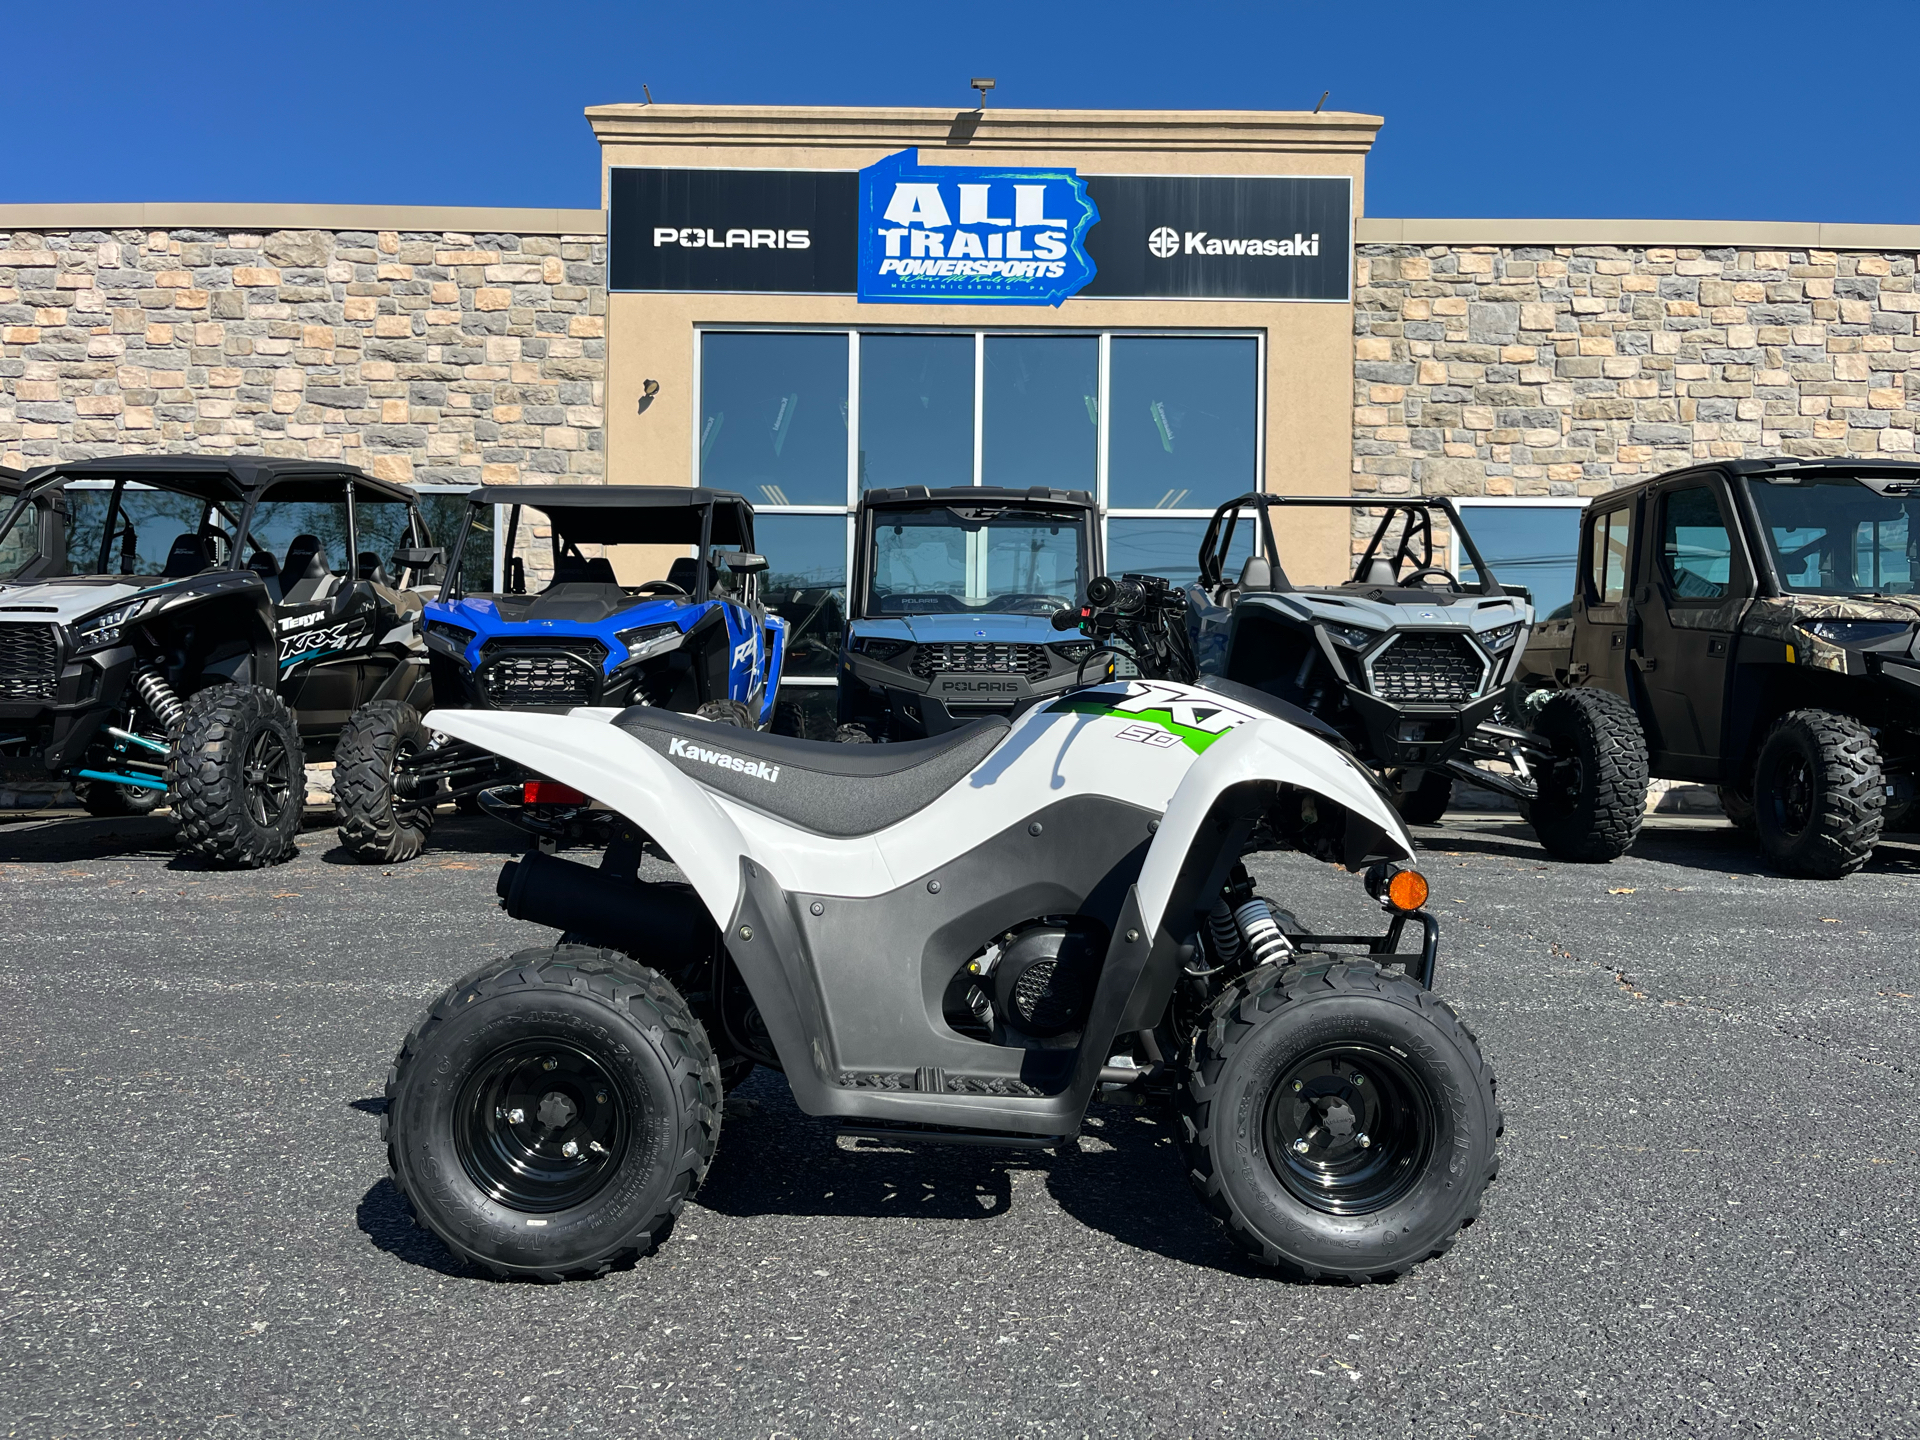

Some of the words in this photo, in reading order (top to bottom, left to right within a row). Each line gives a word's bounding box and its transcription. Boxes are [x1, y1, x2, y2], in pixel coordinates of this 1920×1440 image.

[883, 183, 1067, 229] ALL
[653, 228, 811, 249] POLARIS
[878, 228, 1067, 260] TRAILS
[1184, 231, 1320, 256] Kawasaki
[879, 259, 1066, 278] POWERSPORTS
[942, 682, 1019, 692] POLARIS
[1115, 724, 1186, 748] 50
[669, 738, 780, 783] Kawasaki
[1403, 1033, 1470, 1176] MAXXIS
[420, 1156, 548, 1250] MAXXIS
